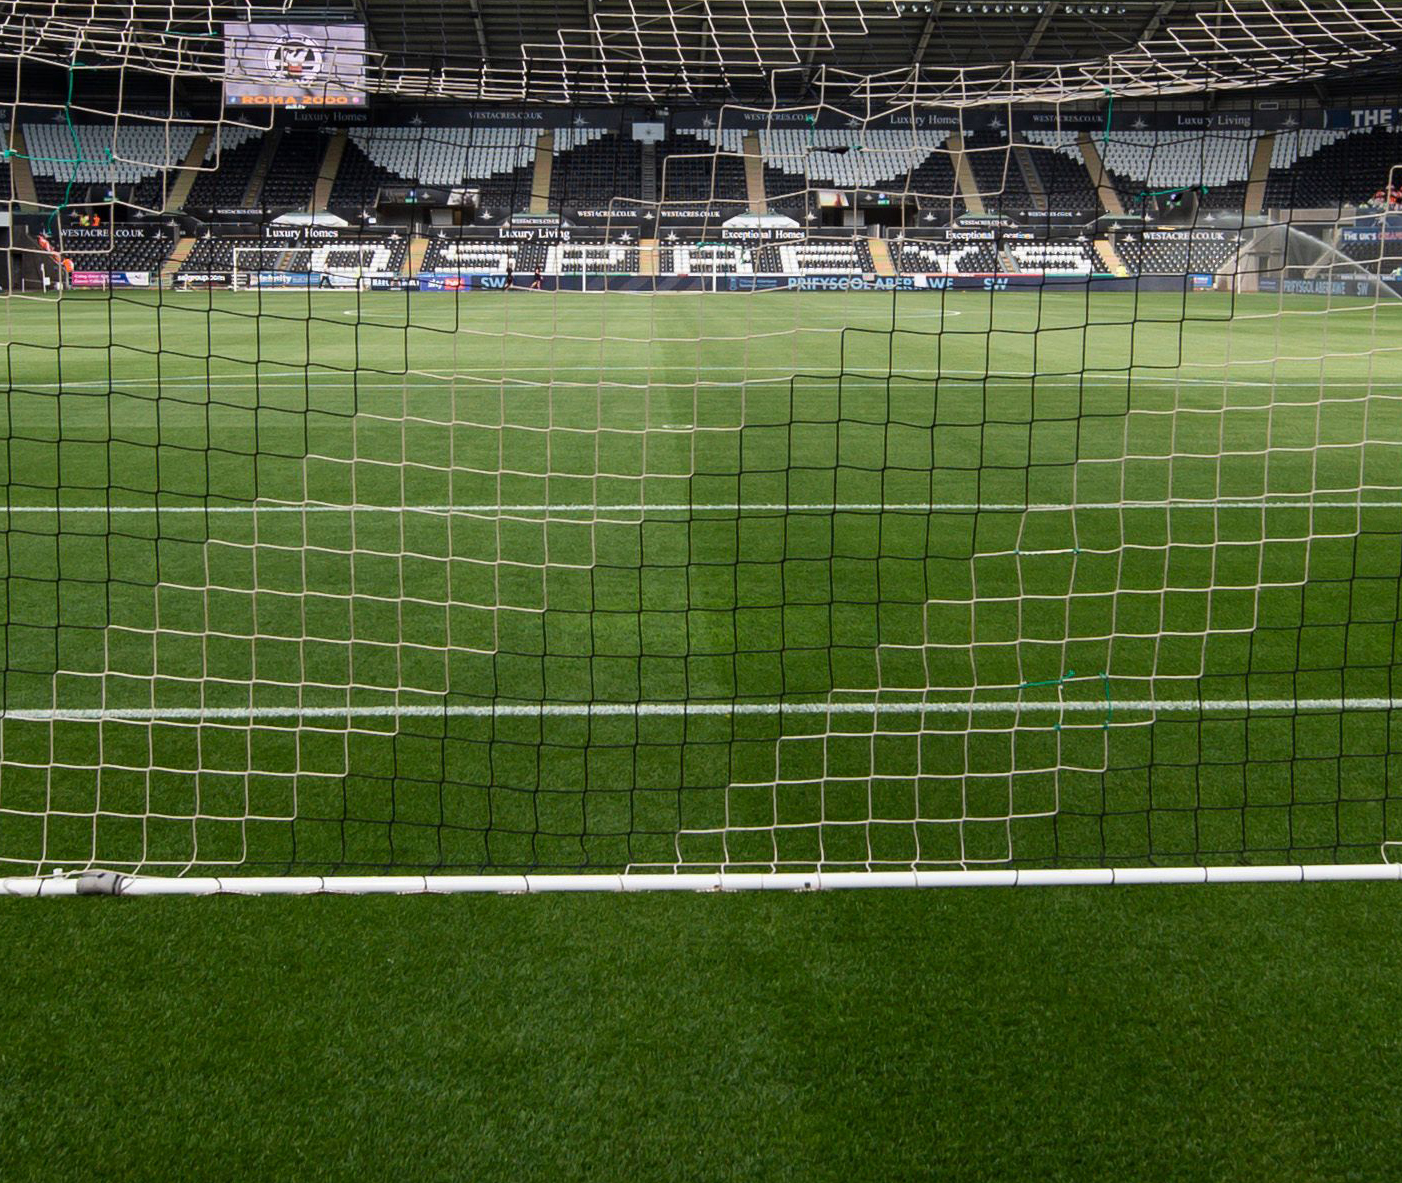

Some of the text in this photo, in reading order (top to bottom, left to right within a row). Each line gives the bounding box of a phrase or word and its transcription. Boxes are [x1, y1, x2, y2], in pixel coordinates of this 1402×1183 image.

[242, 95, 348, 105] ROMA 2000
[294, 111, 367, 123] Luxury Homes
[889, 114, 924, 126] Luxury
[1216, 114, 1251, 127] Living
[1350, 109, 1394, 128] THE
[265, 227, 338, 240] Luxury Homes
[499, 228, 571, 241] Luxury Living
[721, 229, 805, 241] Exceptional Homes
[945, 230, 995, 241] Exceptional
[1343, 231, 1358, 241] THE
[1359, 231, 1377, 241] UK'S
[480, 276, 506, 289] SW
[983, 277, 1009, 291] SW
[1357, 281, 1369, 296] SW
